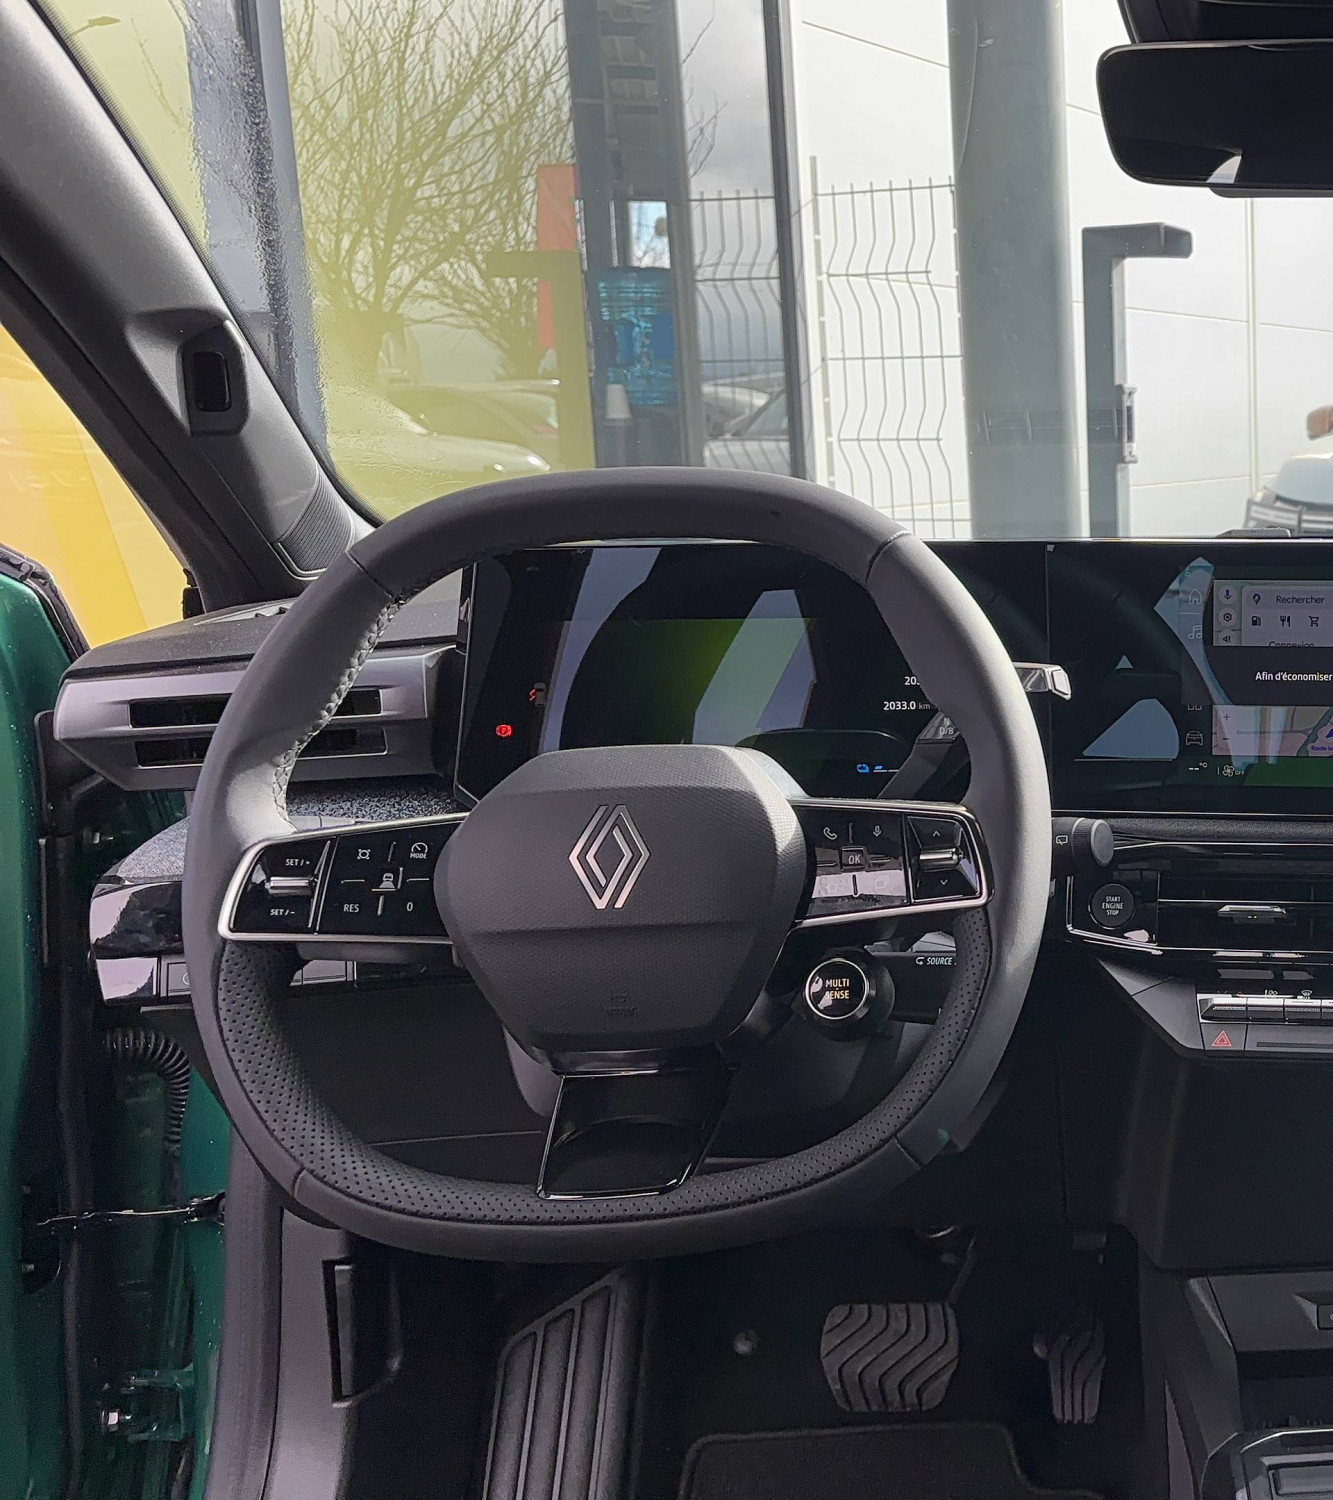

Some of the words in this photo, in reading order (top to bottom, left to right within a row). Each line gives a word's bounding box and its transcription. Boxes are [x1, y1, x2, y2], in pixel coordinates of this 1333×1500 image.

[1276, 595, 1325, 604] Rechercher
[904, 676, 920, 686] 20
[1255, 672, 1273, 681] Afin
[1275, 672, 1332, 681] d'économiser
[883, 701, 916, 711] 2033.0
[939, 726, 954, 735] D/B
[848, 854, 861, 865] OK
[343, 904, 360, 913] RES
[1101, 902, 1124, 910] ENGINE
[926, 956, 952, 965] SOURCE
[825, 978, 850, 987] MULTI
[825, 990, 850, 999] SENSE
